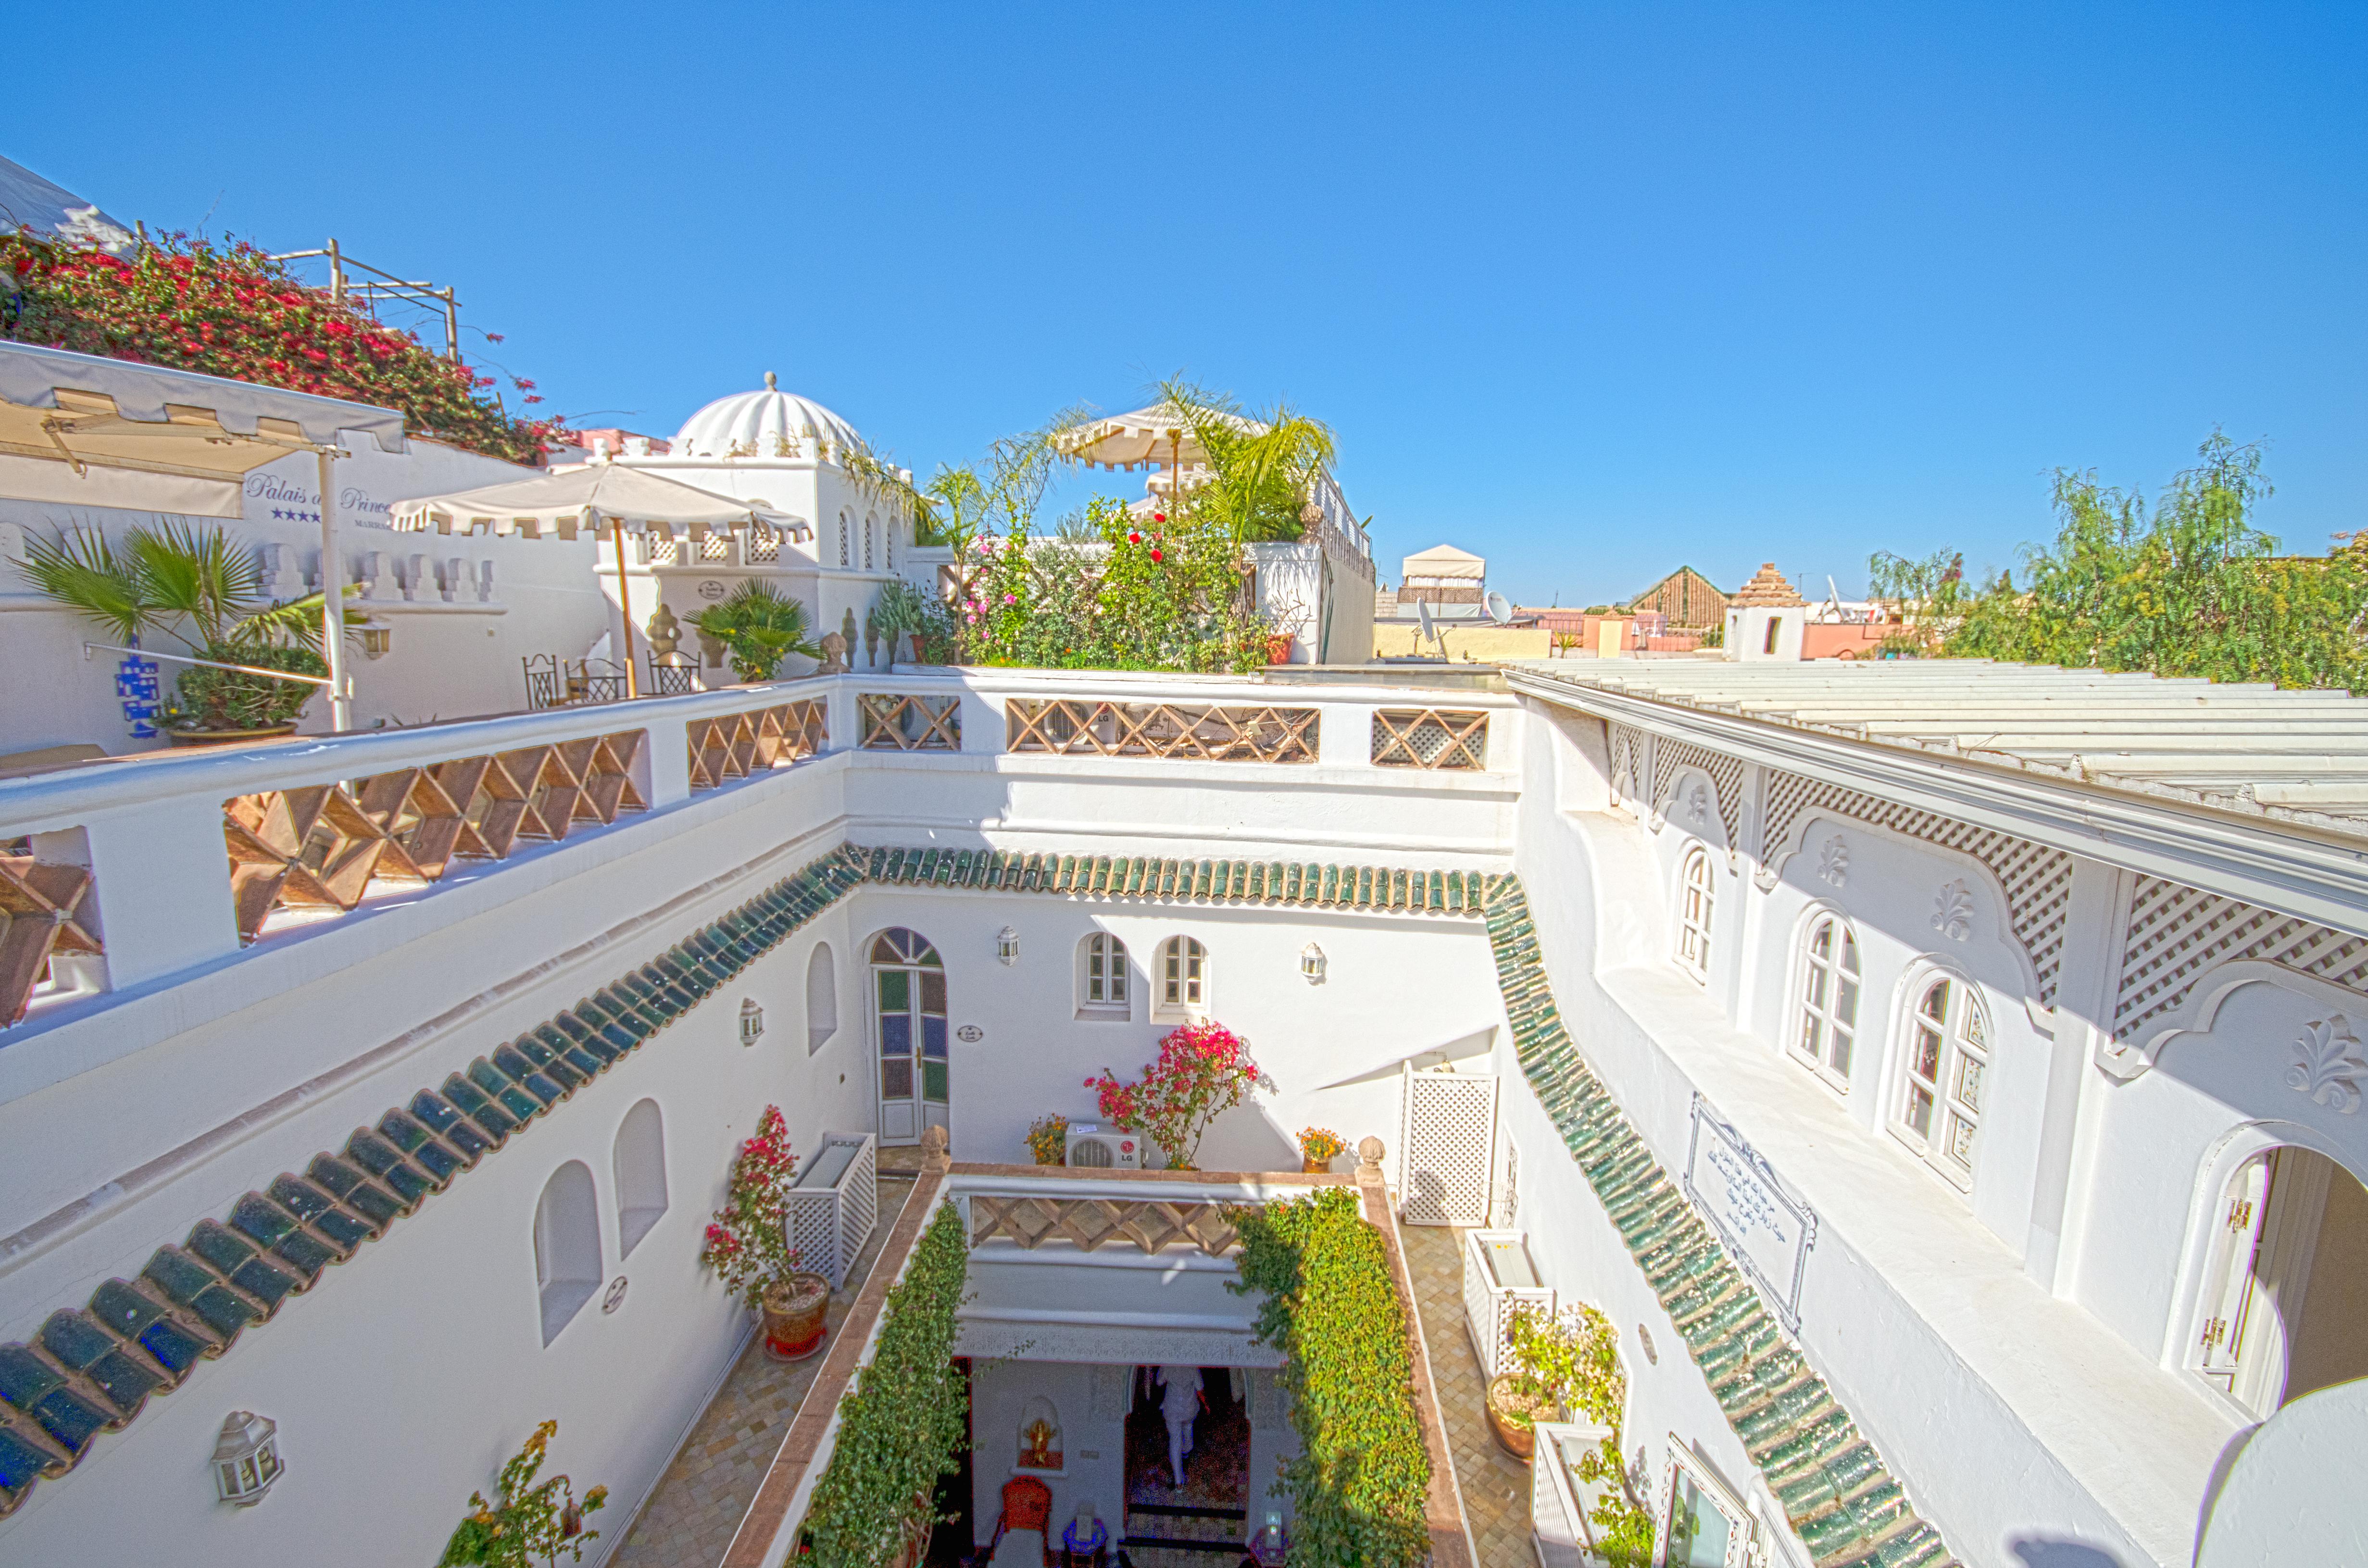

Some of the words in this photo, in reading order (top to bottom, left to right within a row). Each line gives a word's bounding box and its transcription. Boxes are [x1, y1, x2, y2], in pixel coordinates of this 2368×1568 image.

[247, 473, 306, 503] Palais
[340, 488, 391, 514] Prince
[354, 520, 392, 530] MARRA
[1742, 1175, 1750, 1186] في
